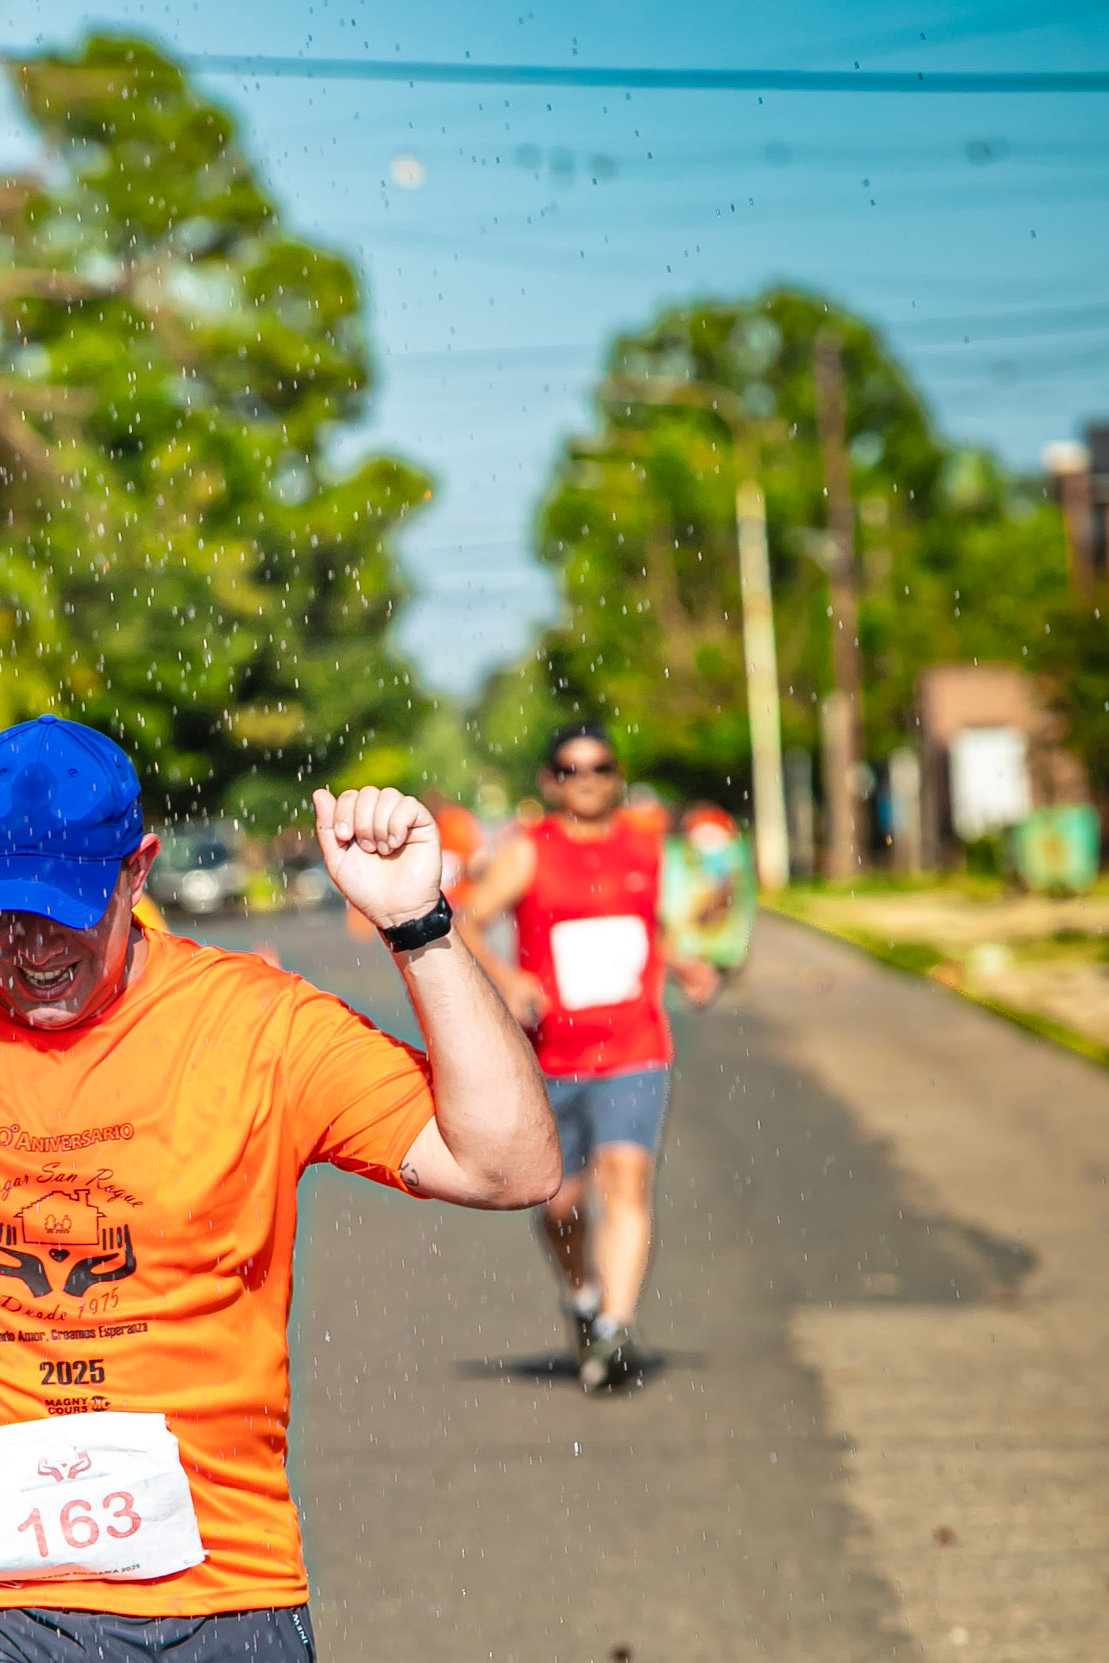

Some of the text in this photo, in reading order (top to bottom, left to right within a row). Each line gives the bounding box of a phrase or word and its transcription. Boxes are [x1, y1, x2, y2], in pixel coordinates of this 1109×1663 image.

[15, 1123, 134, 1153] ANIVERSARIO
[36, 1162, 78, 1184] San
[1, 1287, 120, 1321] Desde 1975
[51, 1328, 96, 1341] Creamos
[98, 1322, 148, 1339] Esperanza
[39, 1358, 105, 1386] 2025
[45, 1397, 88, 1407] MAGNY
[48, 1406, 88, 1415] COURS
[17, 1491, 141, 1557] 163
